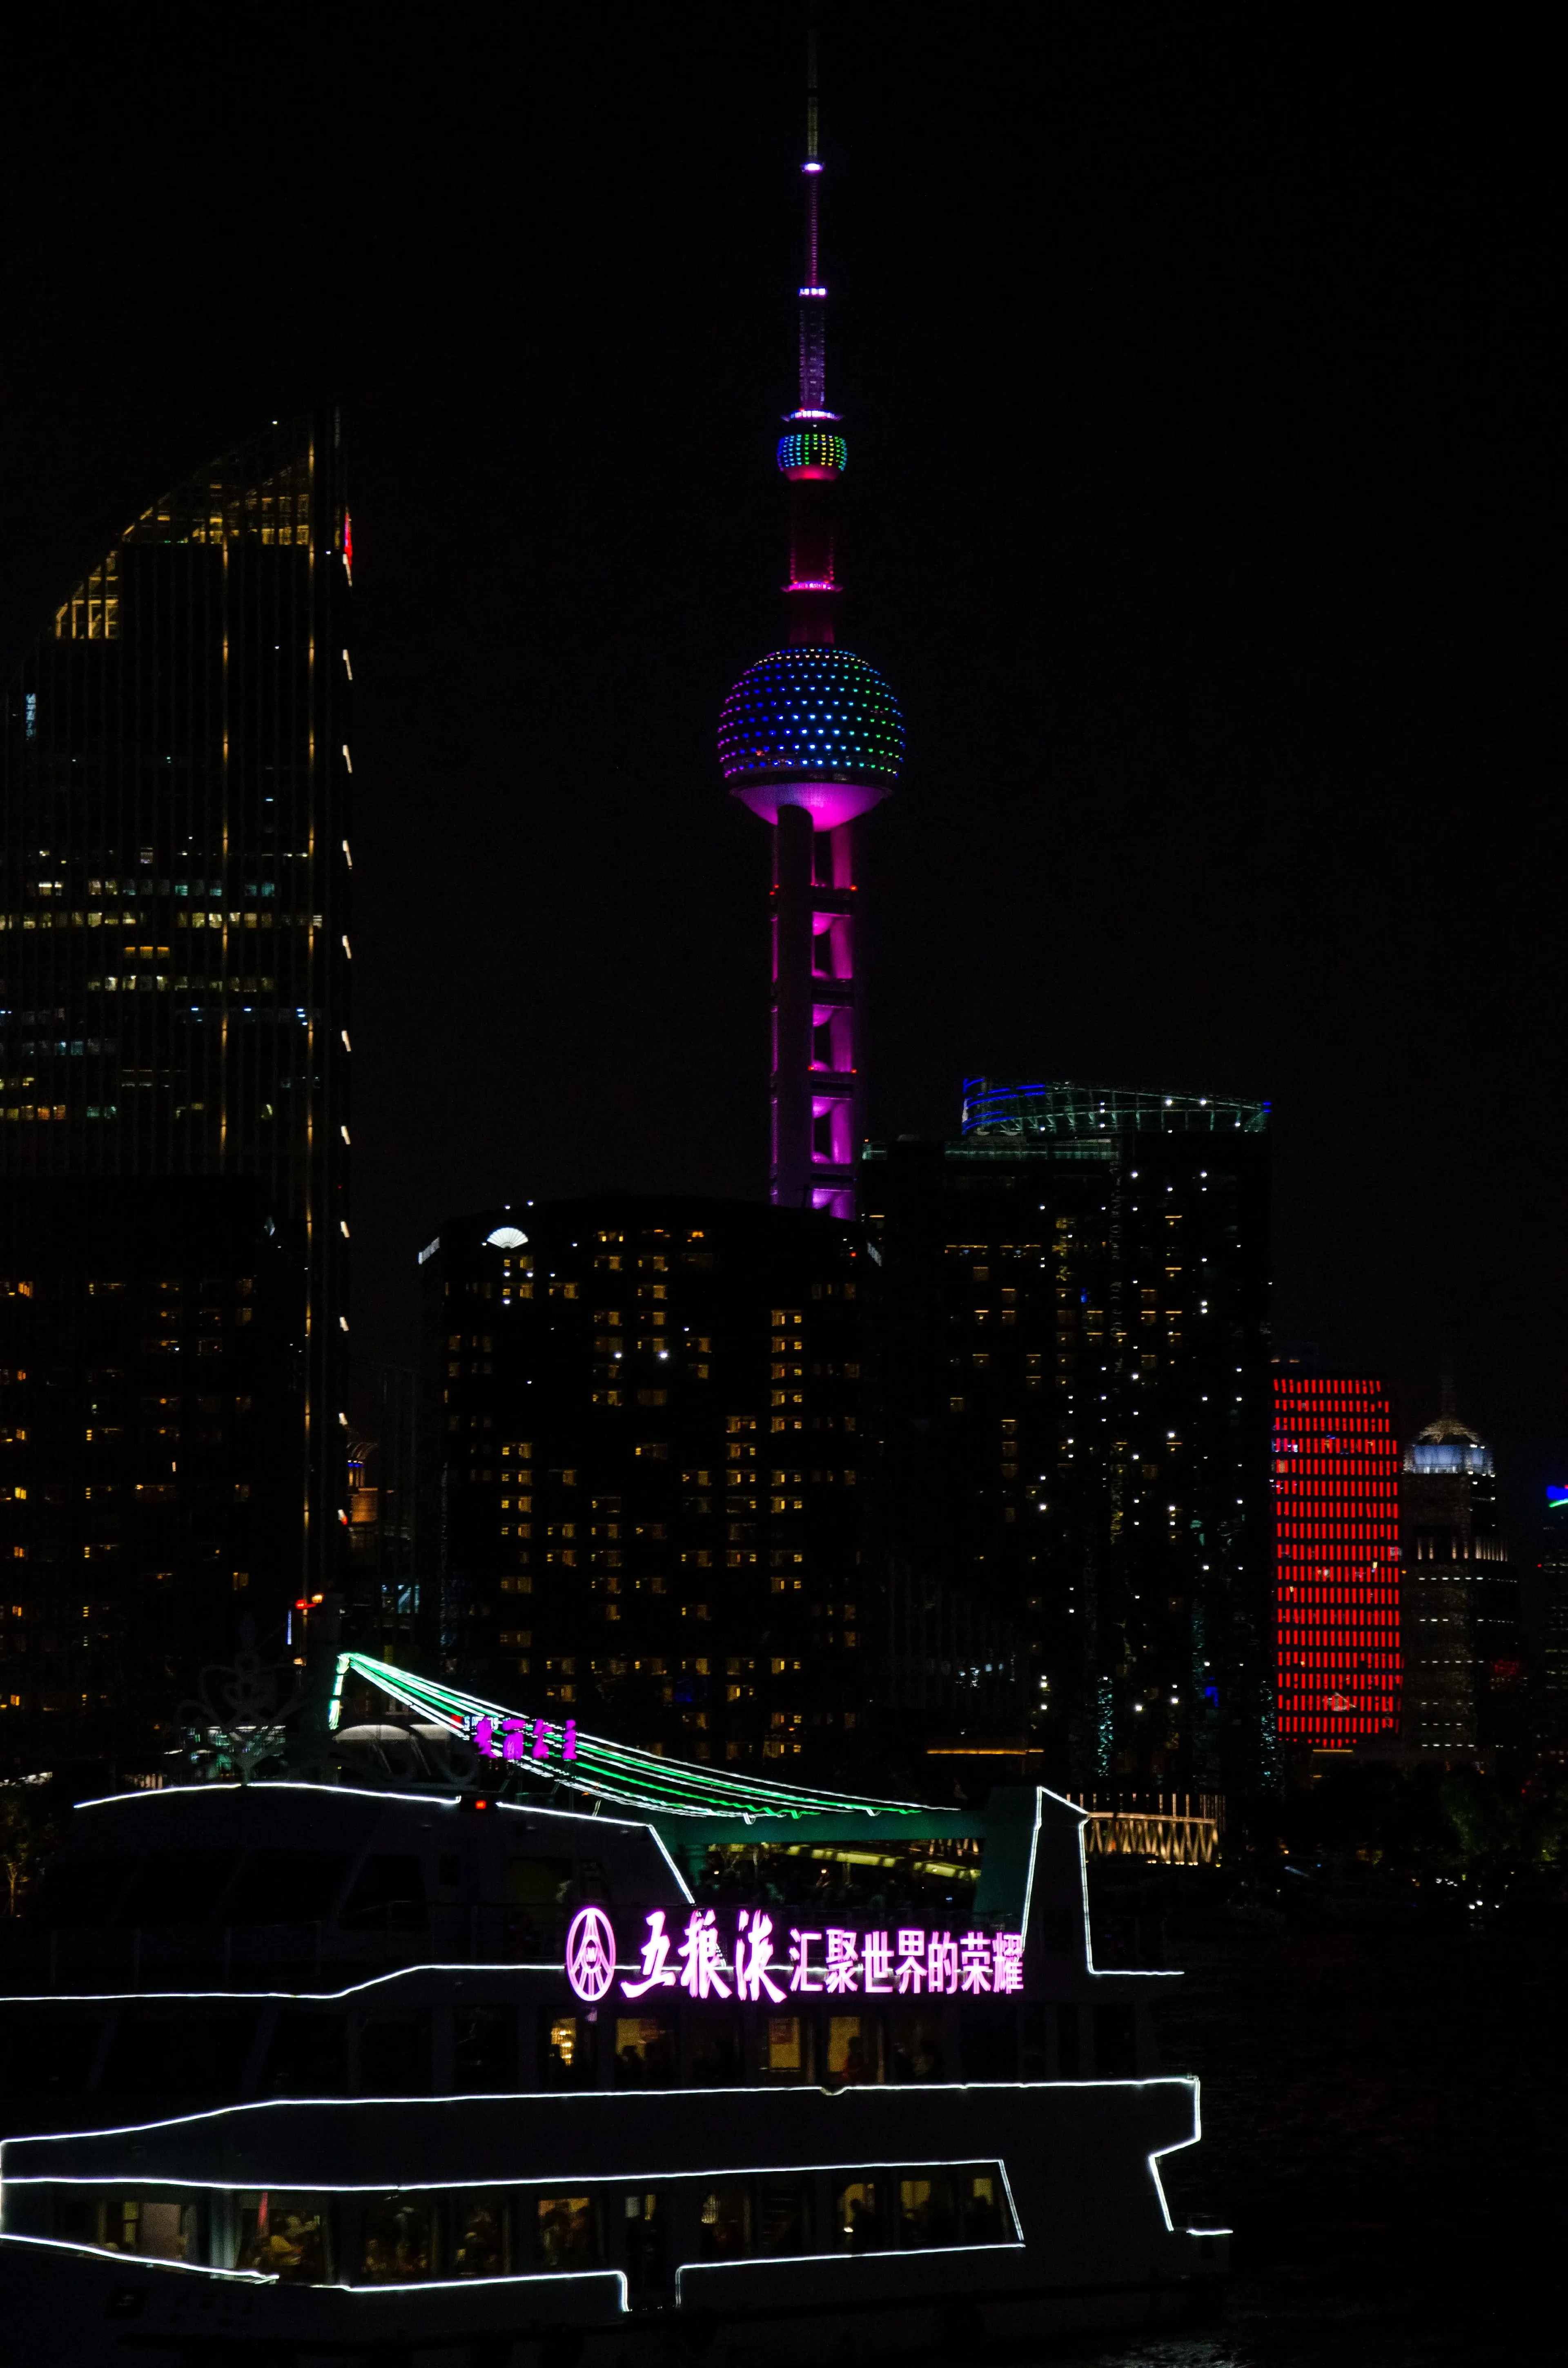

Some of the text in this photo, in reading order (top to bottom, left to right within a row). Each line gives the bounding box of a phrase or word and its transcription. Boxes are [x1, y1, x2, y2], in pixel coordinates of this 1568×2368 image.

[620, 1909, 1025, 2003] 五粮液 汇聚世界的荣耀
